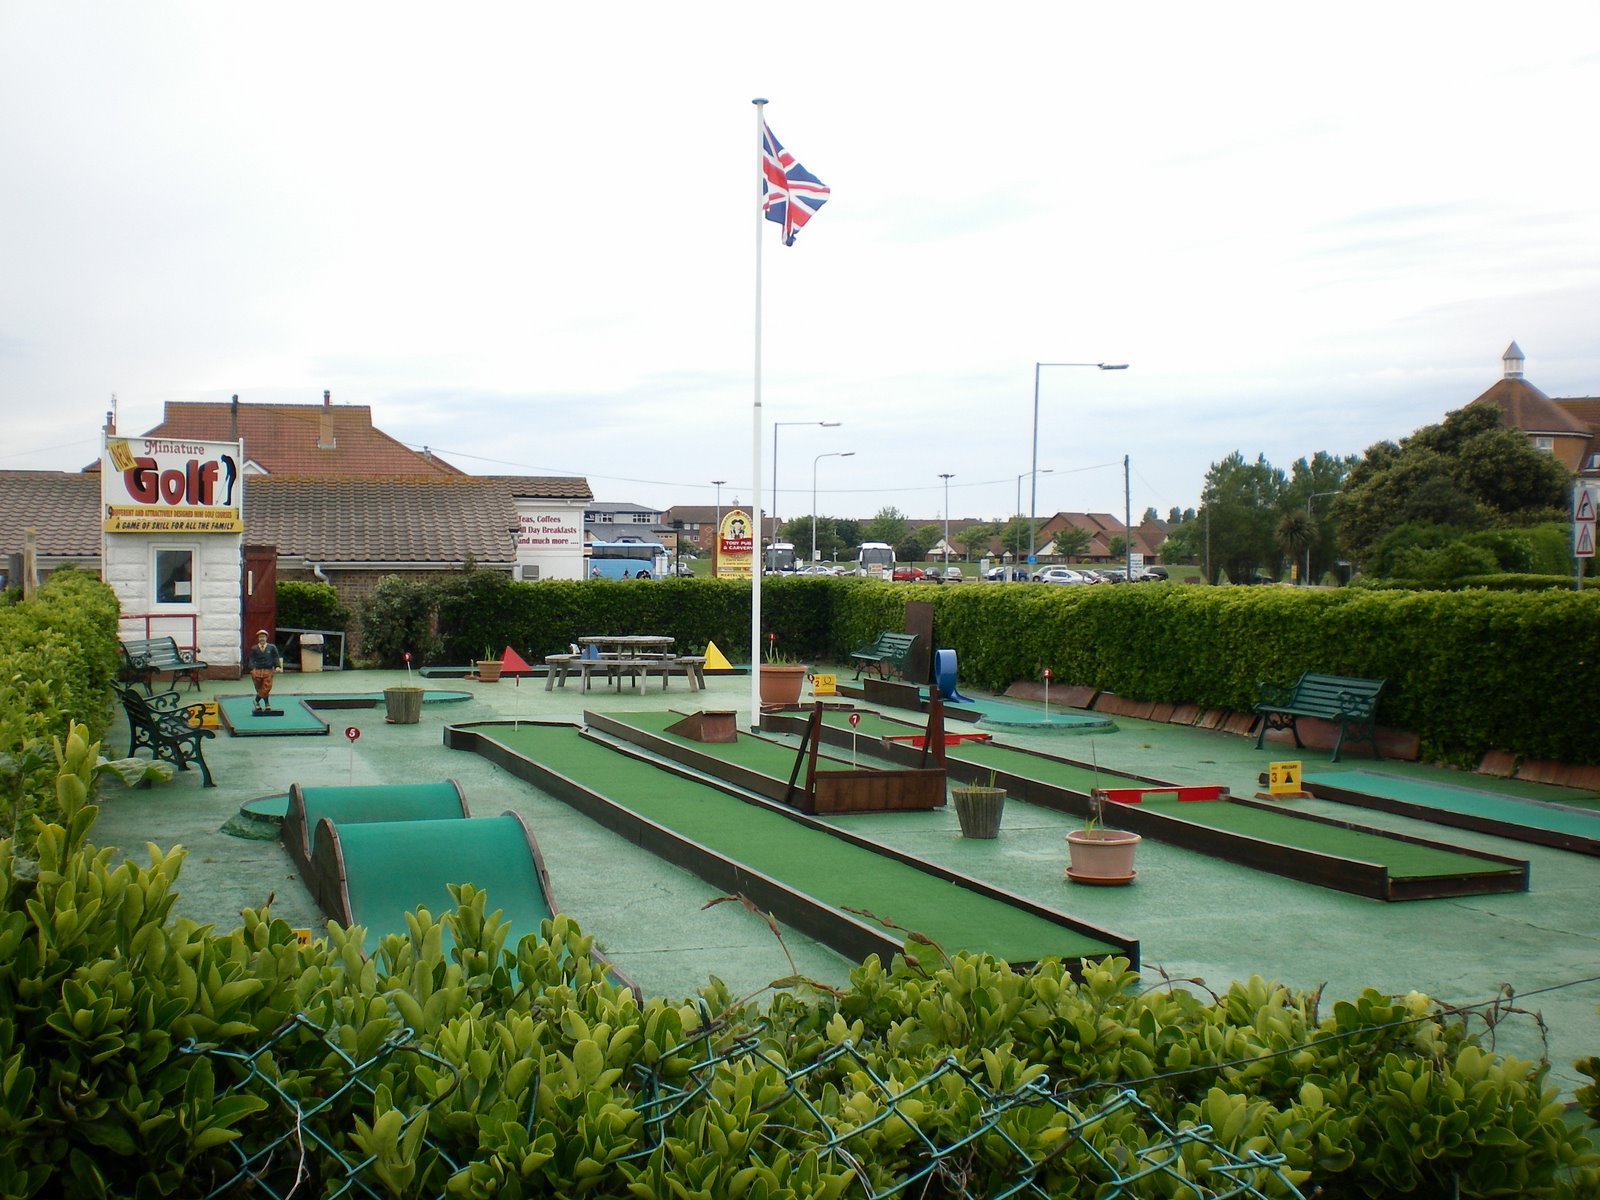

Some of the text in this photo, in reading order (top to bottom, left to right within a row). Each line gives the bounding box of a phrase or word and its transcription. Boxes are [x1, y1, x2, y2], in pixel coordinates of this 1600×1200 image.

[144, 440, 205, 455] Miniature
[111, 442, 134, 470] NEW
[123, 457, 219, 505] Golf
[537, 515, 561, 523] Coffees
[116, 521, 235, 530] A GAME OF SKILL FOR ALL THE FAMILY
[529, 526, 540, 535] Day
[543, 526, 577, 534] Breakfasts
[815, 680, 820, 688] 2
[852, 715, 858, 724] 7
[349, 728, 356, 738] 5
[1271, 772, 1278, 784] 3
